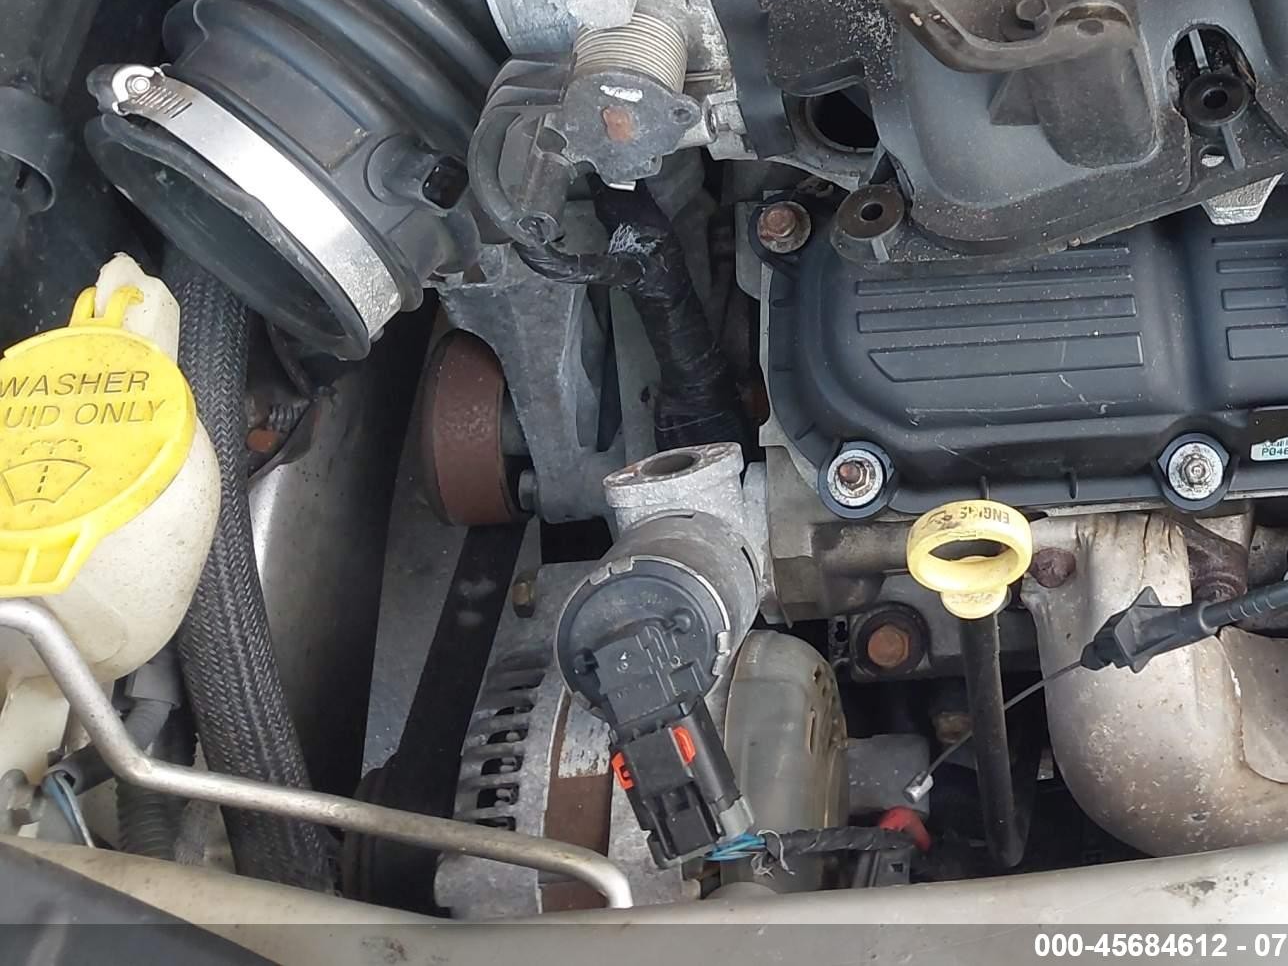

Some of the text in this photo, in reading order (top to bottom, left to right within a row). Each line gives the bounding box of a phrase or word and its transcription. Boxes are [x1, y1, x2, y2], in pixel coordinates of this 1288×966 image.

[0, 370, 150, 397] WASHER
[4, 399, 166, 428] UID ONLY
